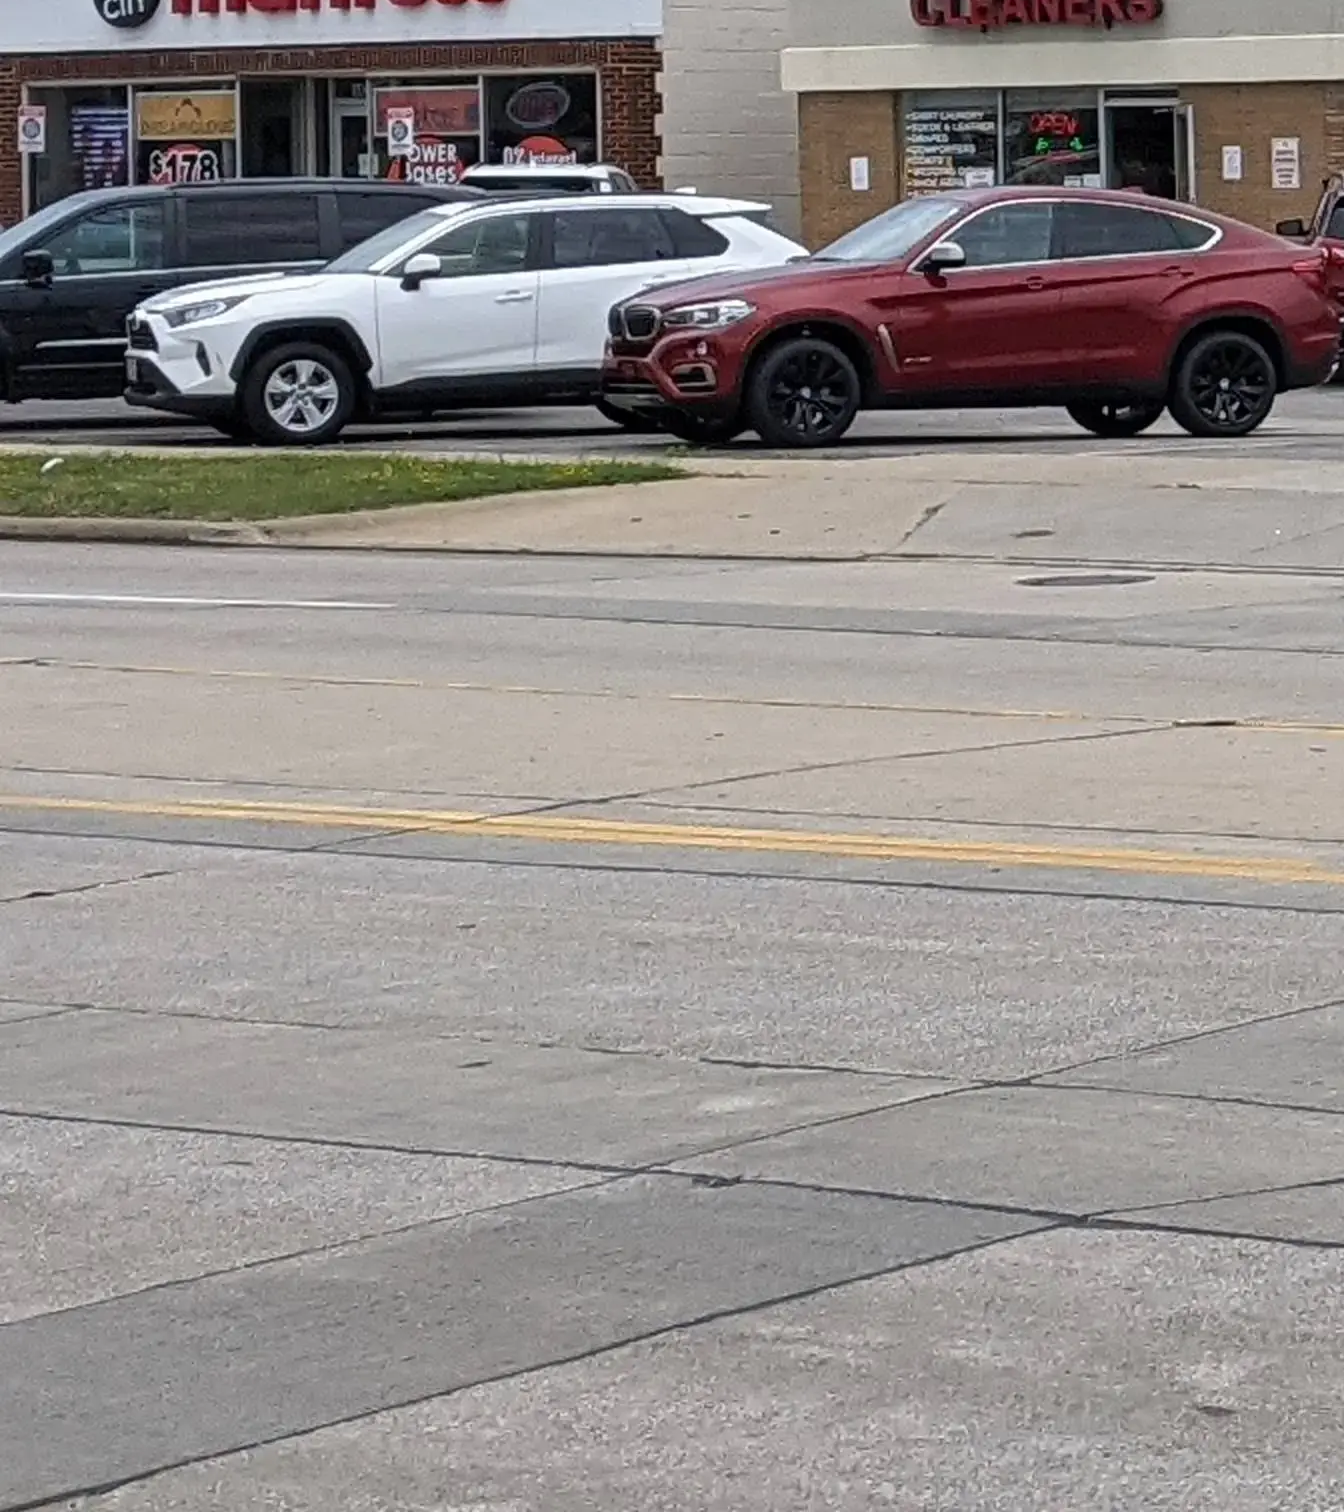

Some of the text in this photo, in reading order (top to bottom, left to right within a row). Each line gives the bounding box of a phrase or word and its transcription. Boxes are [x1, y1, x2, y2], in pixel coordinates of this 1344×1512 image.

[1029, 112, 1080, 135] OPEN
[407, 143, 457, 163] OWER
[150, 149, 218, 183] $178
